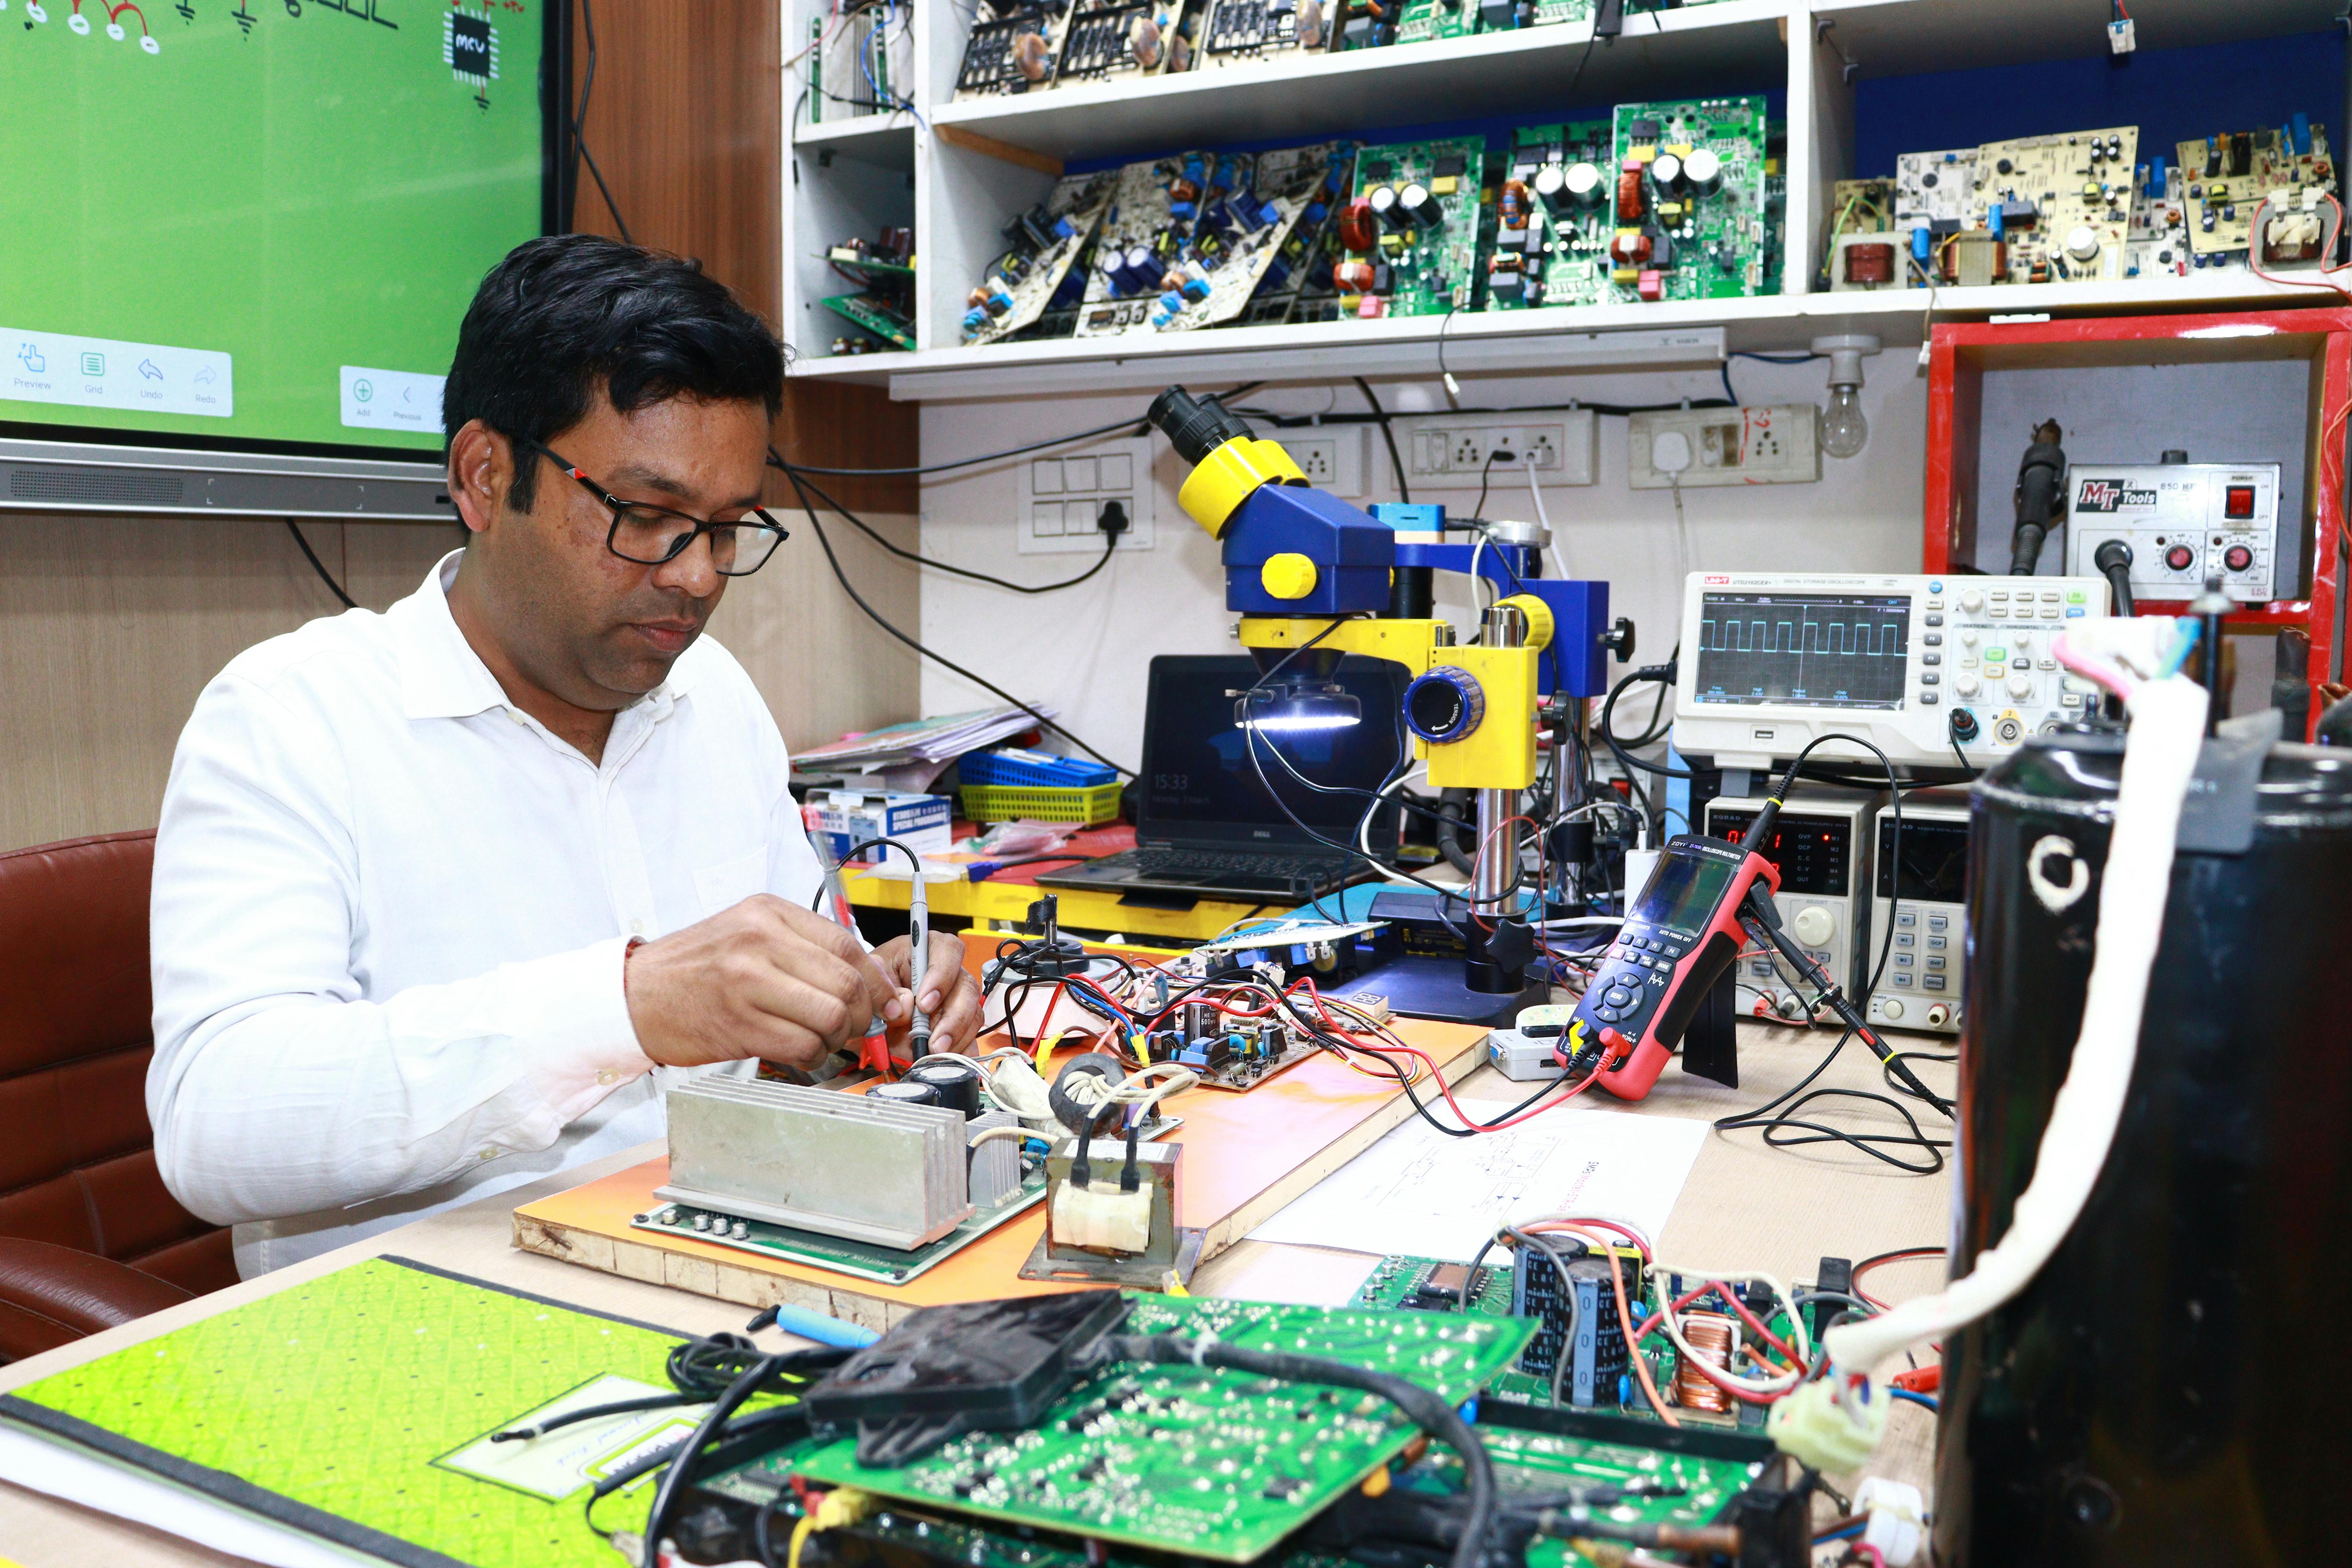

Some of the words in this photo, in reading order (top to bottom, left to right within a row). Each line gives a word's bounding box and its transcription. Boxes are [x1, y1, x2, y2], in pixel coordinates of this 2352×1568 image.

[14, 377, 51, 389] Preview
[85, 385, 103, 394] Grid
[140, 390, 163, 399] Undo
[196, 394, 216, 404] Redo
[394, 411, 421, 421] Previous
[2123, 491, 2155, 504] Tools
[1449, 703, 1459, 724] TENSION
[1154, 774, 1188, 789] 15:33
[1702, 846, 1723, 855] OSCILLOSCOPE
[1722, 850, 1741, 860] MULTIMETER
[1610, 992, 1623, 1000] MENU
[1528, 1261, 1538, 1269] CE
[1598, 1298, 1610, 1308] CE
